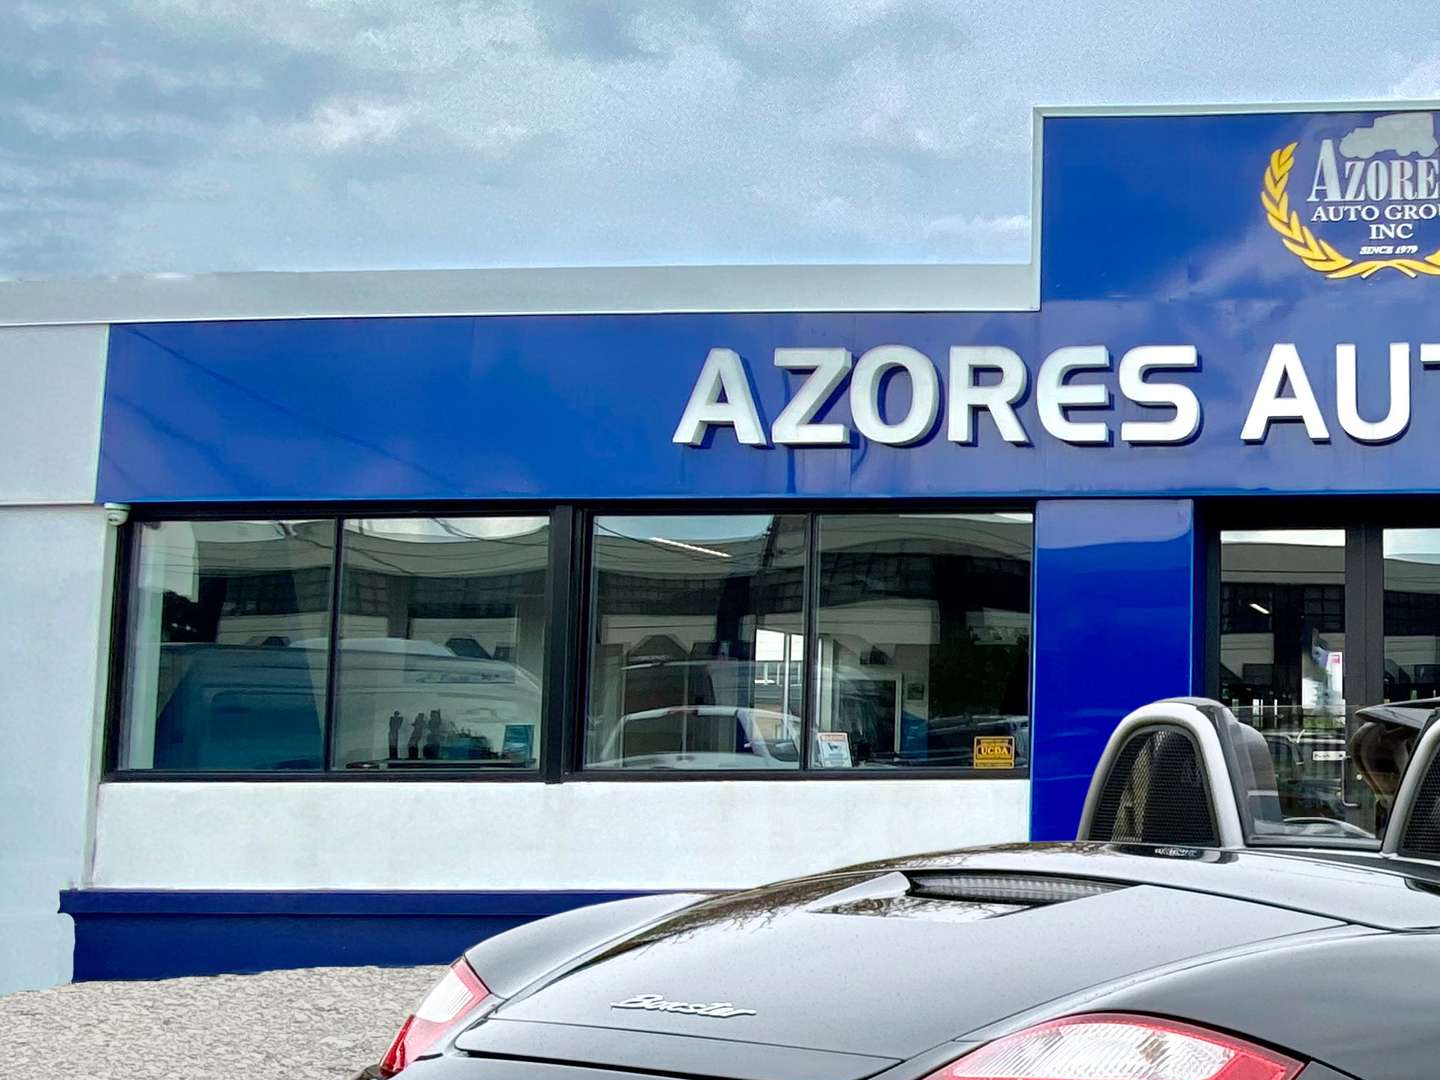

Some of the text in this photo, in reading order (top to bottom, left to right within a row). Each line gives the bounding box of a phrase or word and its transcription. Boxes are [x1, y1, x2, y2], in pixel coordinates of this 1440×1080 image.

[1311, 204, 1379, 223] AUTO
[1369, 223, 1414, 241] INC
[1360, 245, 1418, 255] SINCE 1979
[672, 344, 1203, 446] AZORES
[981, 746, 1010, 755] UCDA
